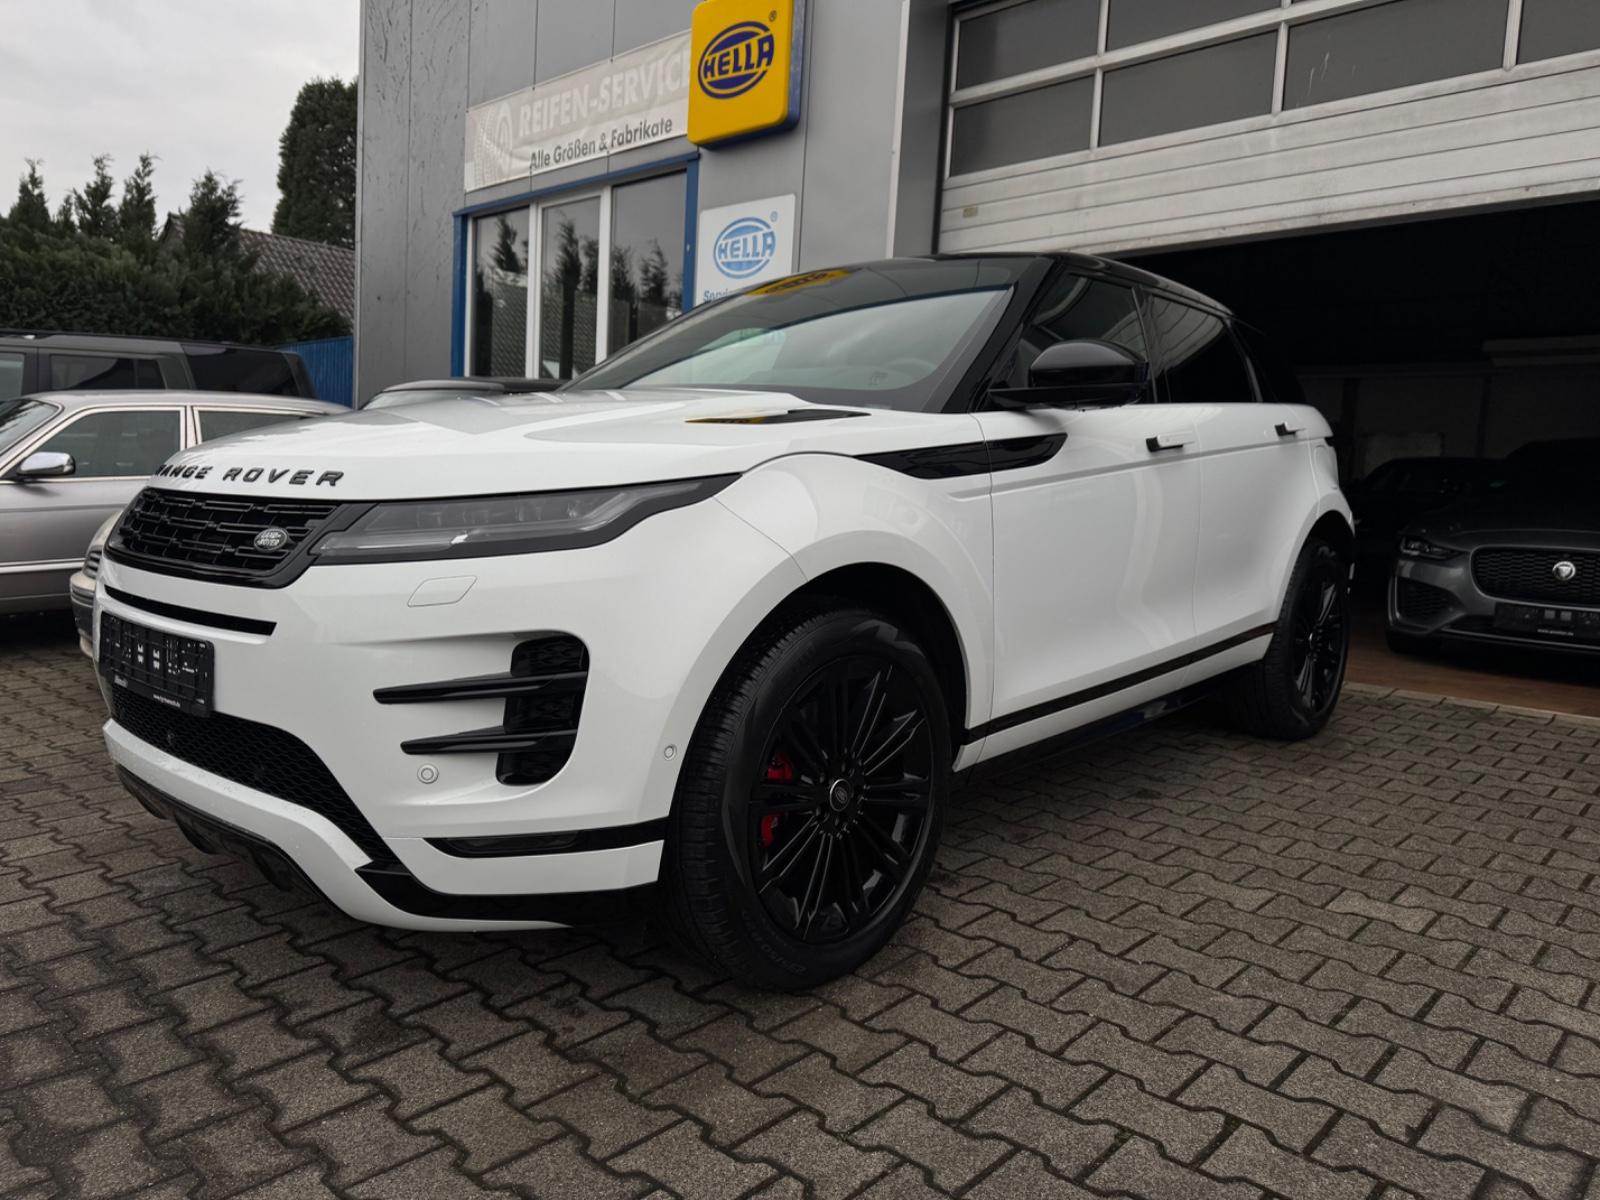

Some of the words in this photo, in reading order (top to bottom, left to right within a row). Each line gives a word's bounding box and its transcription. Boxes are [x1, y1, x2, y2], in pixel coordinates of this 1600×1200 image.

[703, 33, 775, 80] HELLA
[529, 151, 551, 169] Alle
[553, 138, 596, 164] Größen
[599, 132, 608, 151] &
[610, 118, 673, 148] Fabrikate
[717, 230, 777, 260] HELLA
[222, 467, 344, 486] ROVER
